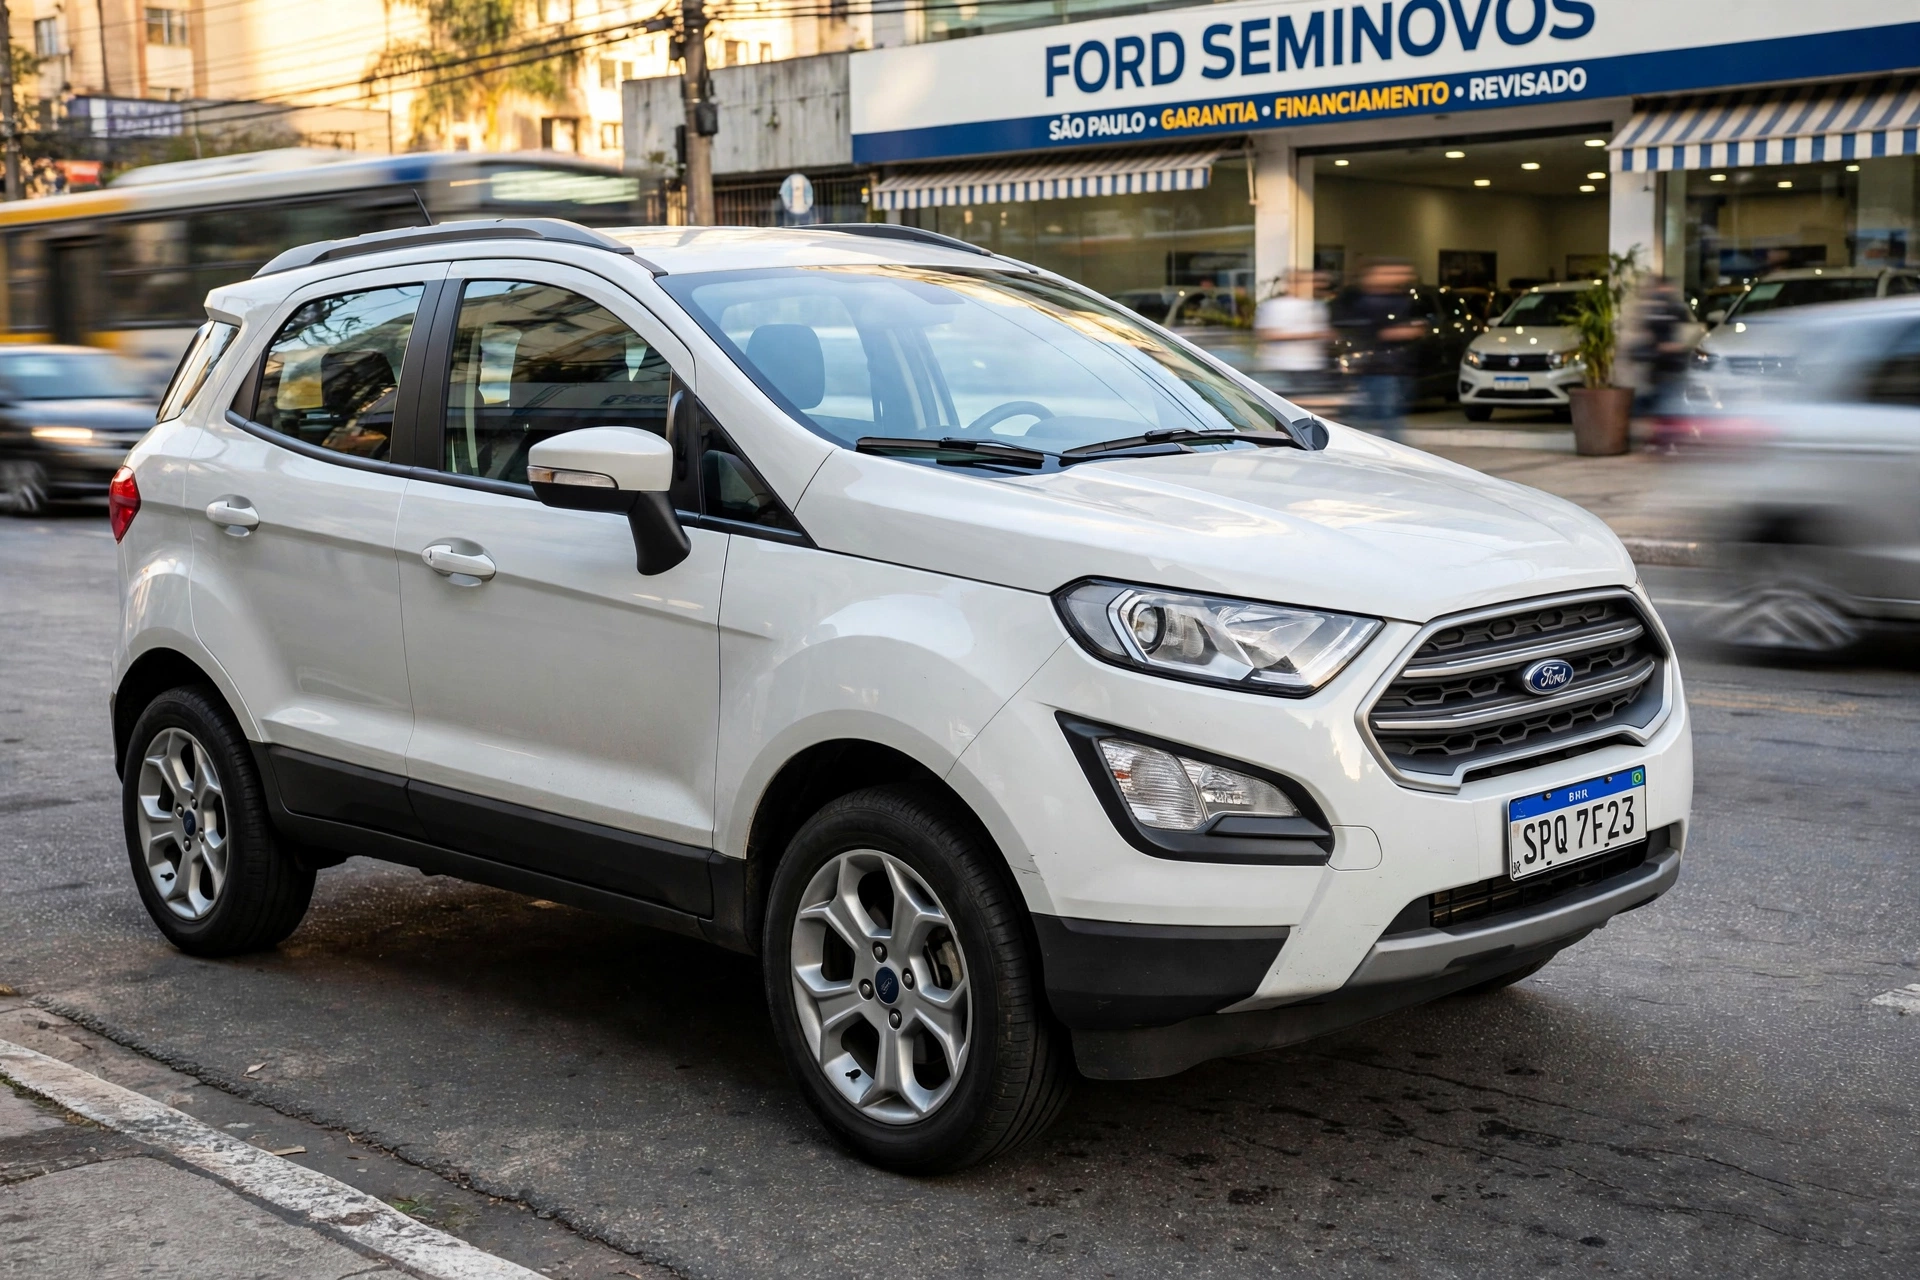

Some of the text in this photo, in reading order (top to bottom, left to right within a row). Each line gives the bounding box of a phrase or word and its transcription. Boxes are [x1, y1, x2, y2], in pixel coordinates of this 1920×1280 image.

[1046, 0, 1595, 98] FORD SEMINOVOS
[1049, 67, 1587, 140] SÃO PAULO GARANTIA FINANCIAMENTO REVISADO
[1541, 665, 1567, 687] Ford
[1523, 795, 1635, 865] SPQ 7F23
